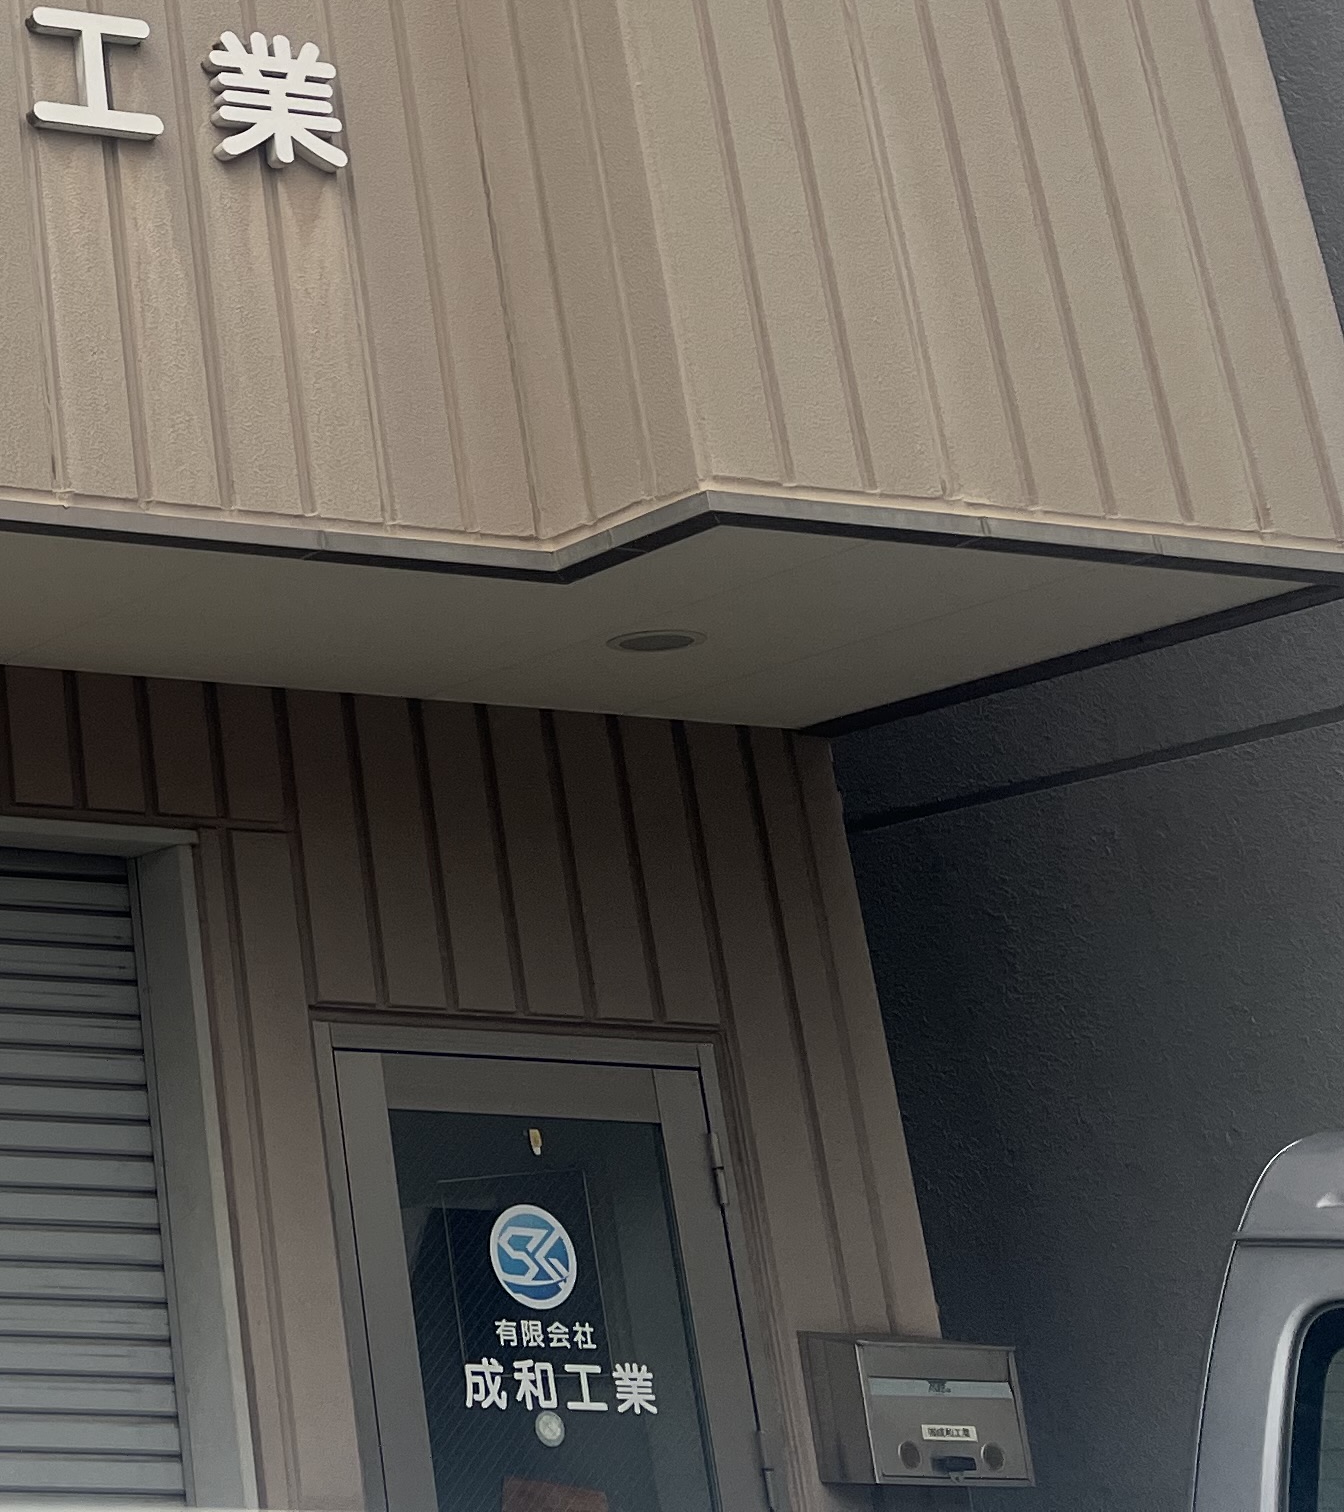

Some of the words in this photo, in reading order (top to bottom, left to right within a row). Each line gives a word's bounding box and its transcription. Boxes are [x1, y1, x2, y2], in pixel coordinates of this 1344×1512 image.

[493, 1318, 598, 1350] 有限会社
[464, 1357, 659, 1415] 成和工業
